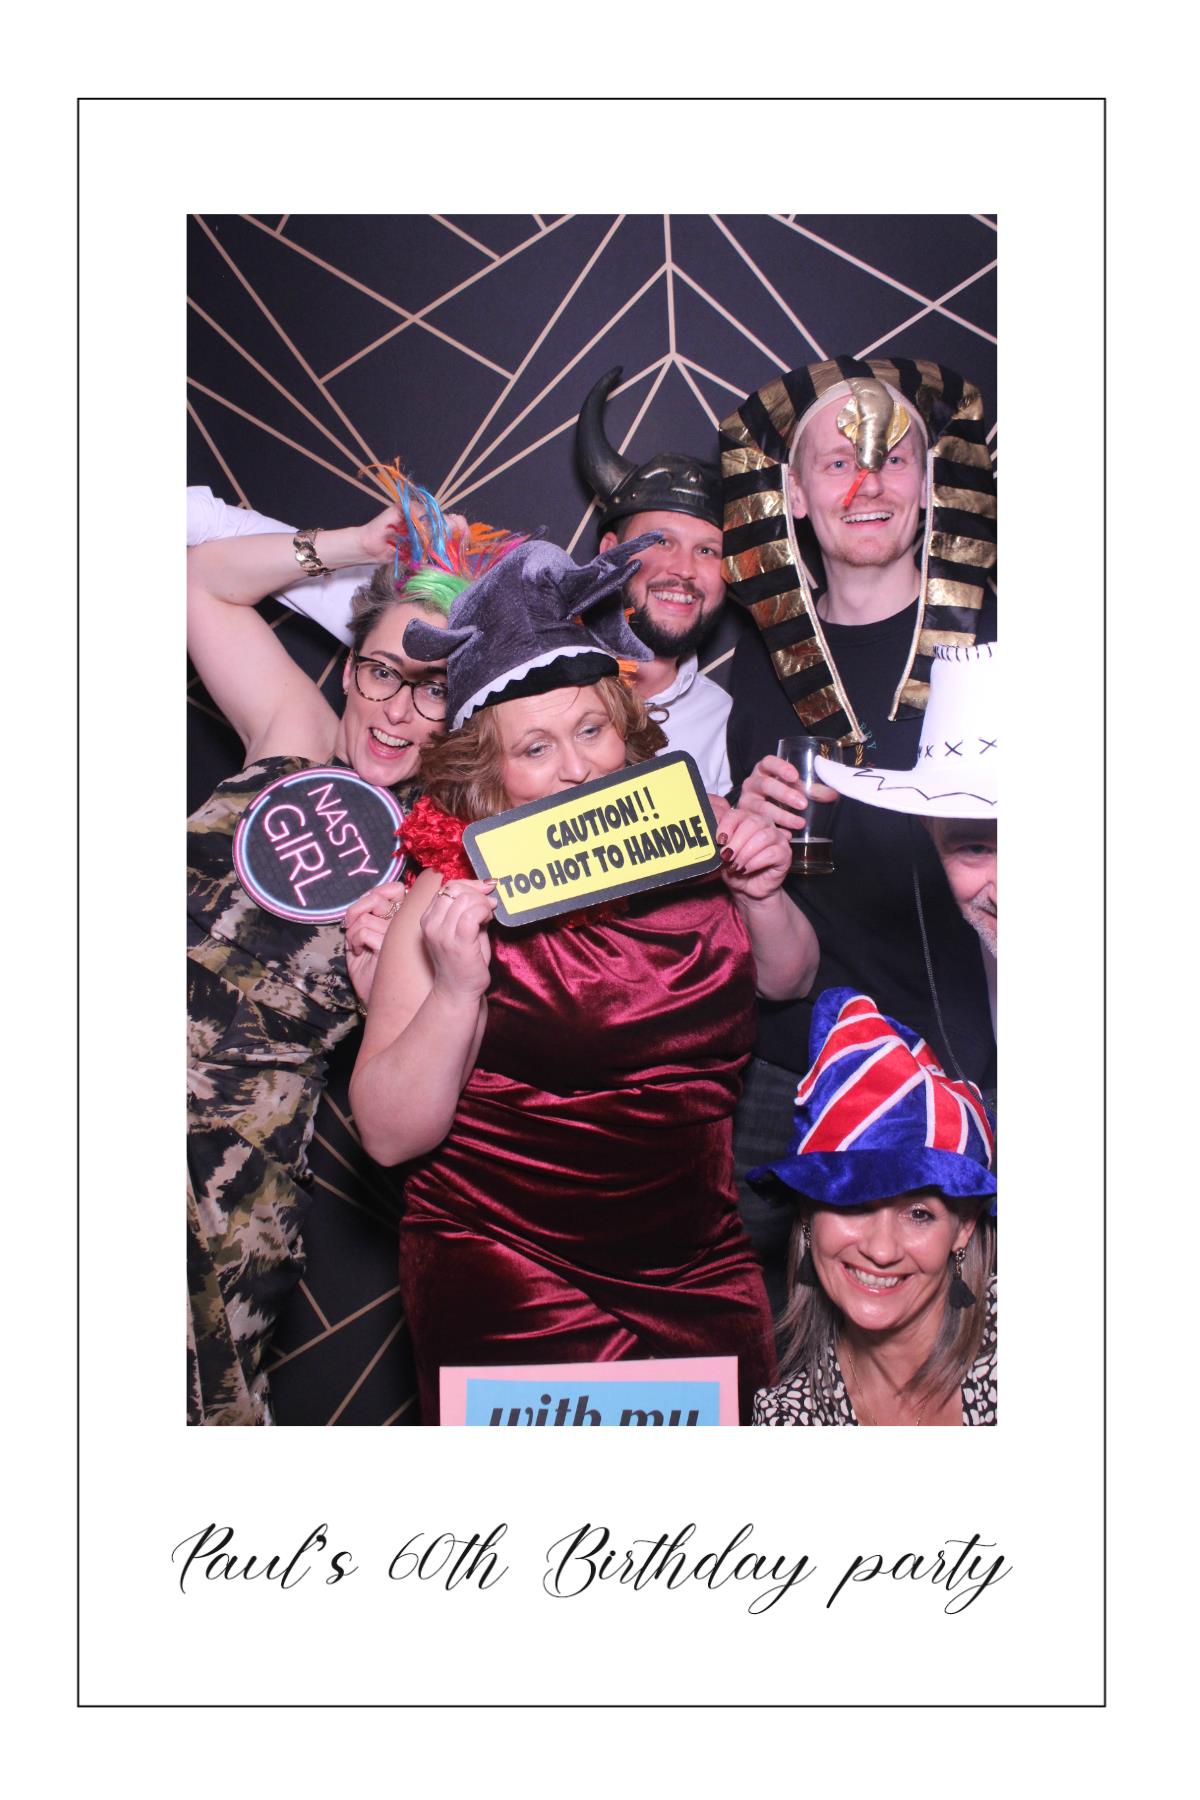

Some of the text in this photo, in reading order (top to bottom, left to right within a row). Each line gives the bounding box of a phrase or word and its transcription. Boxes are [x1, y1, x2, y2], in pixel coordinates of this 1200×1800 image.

[264, 804, 332, 907] GIRL
[307, 783, 379, 876] NASTY
[500, 815, 709, 899] TOO HOT TO HANDLE
[546, 786, 660, 850] CAUTION!!
